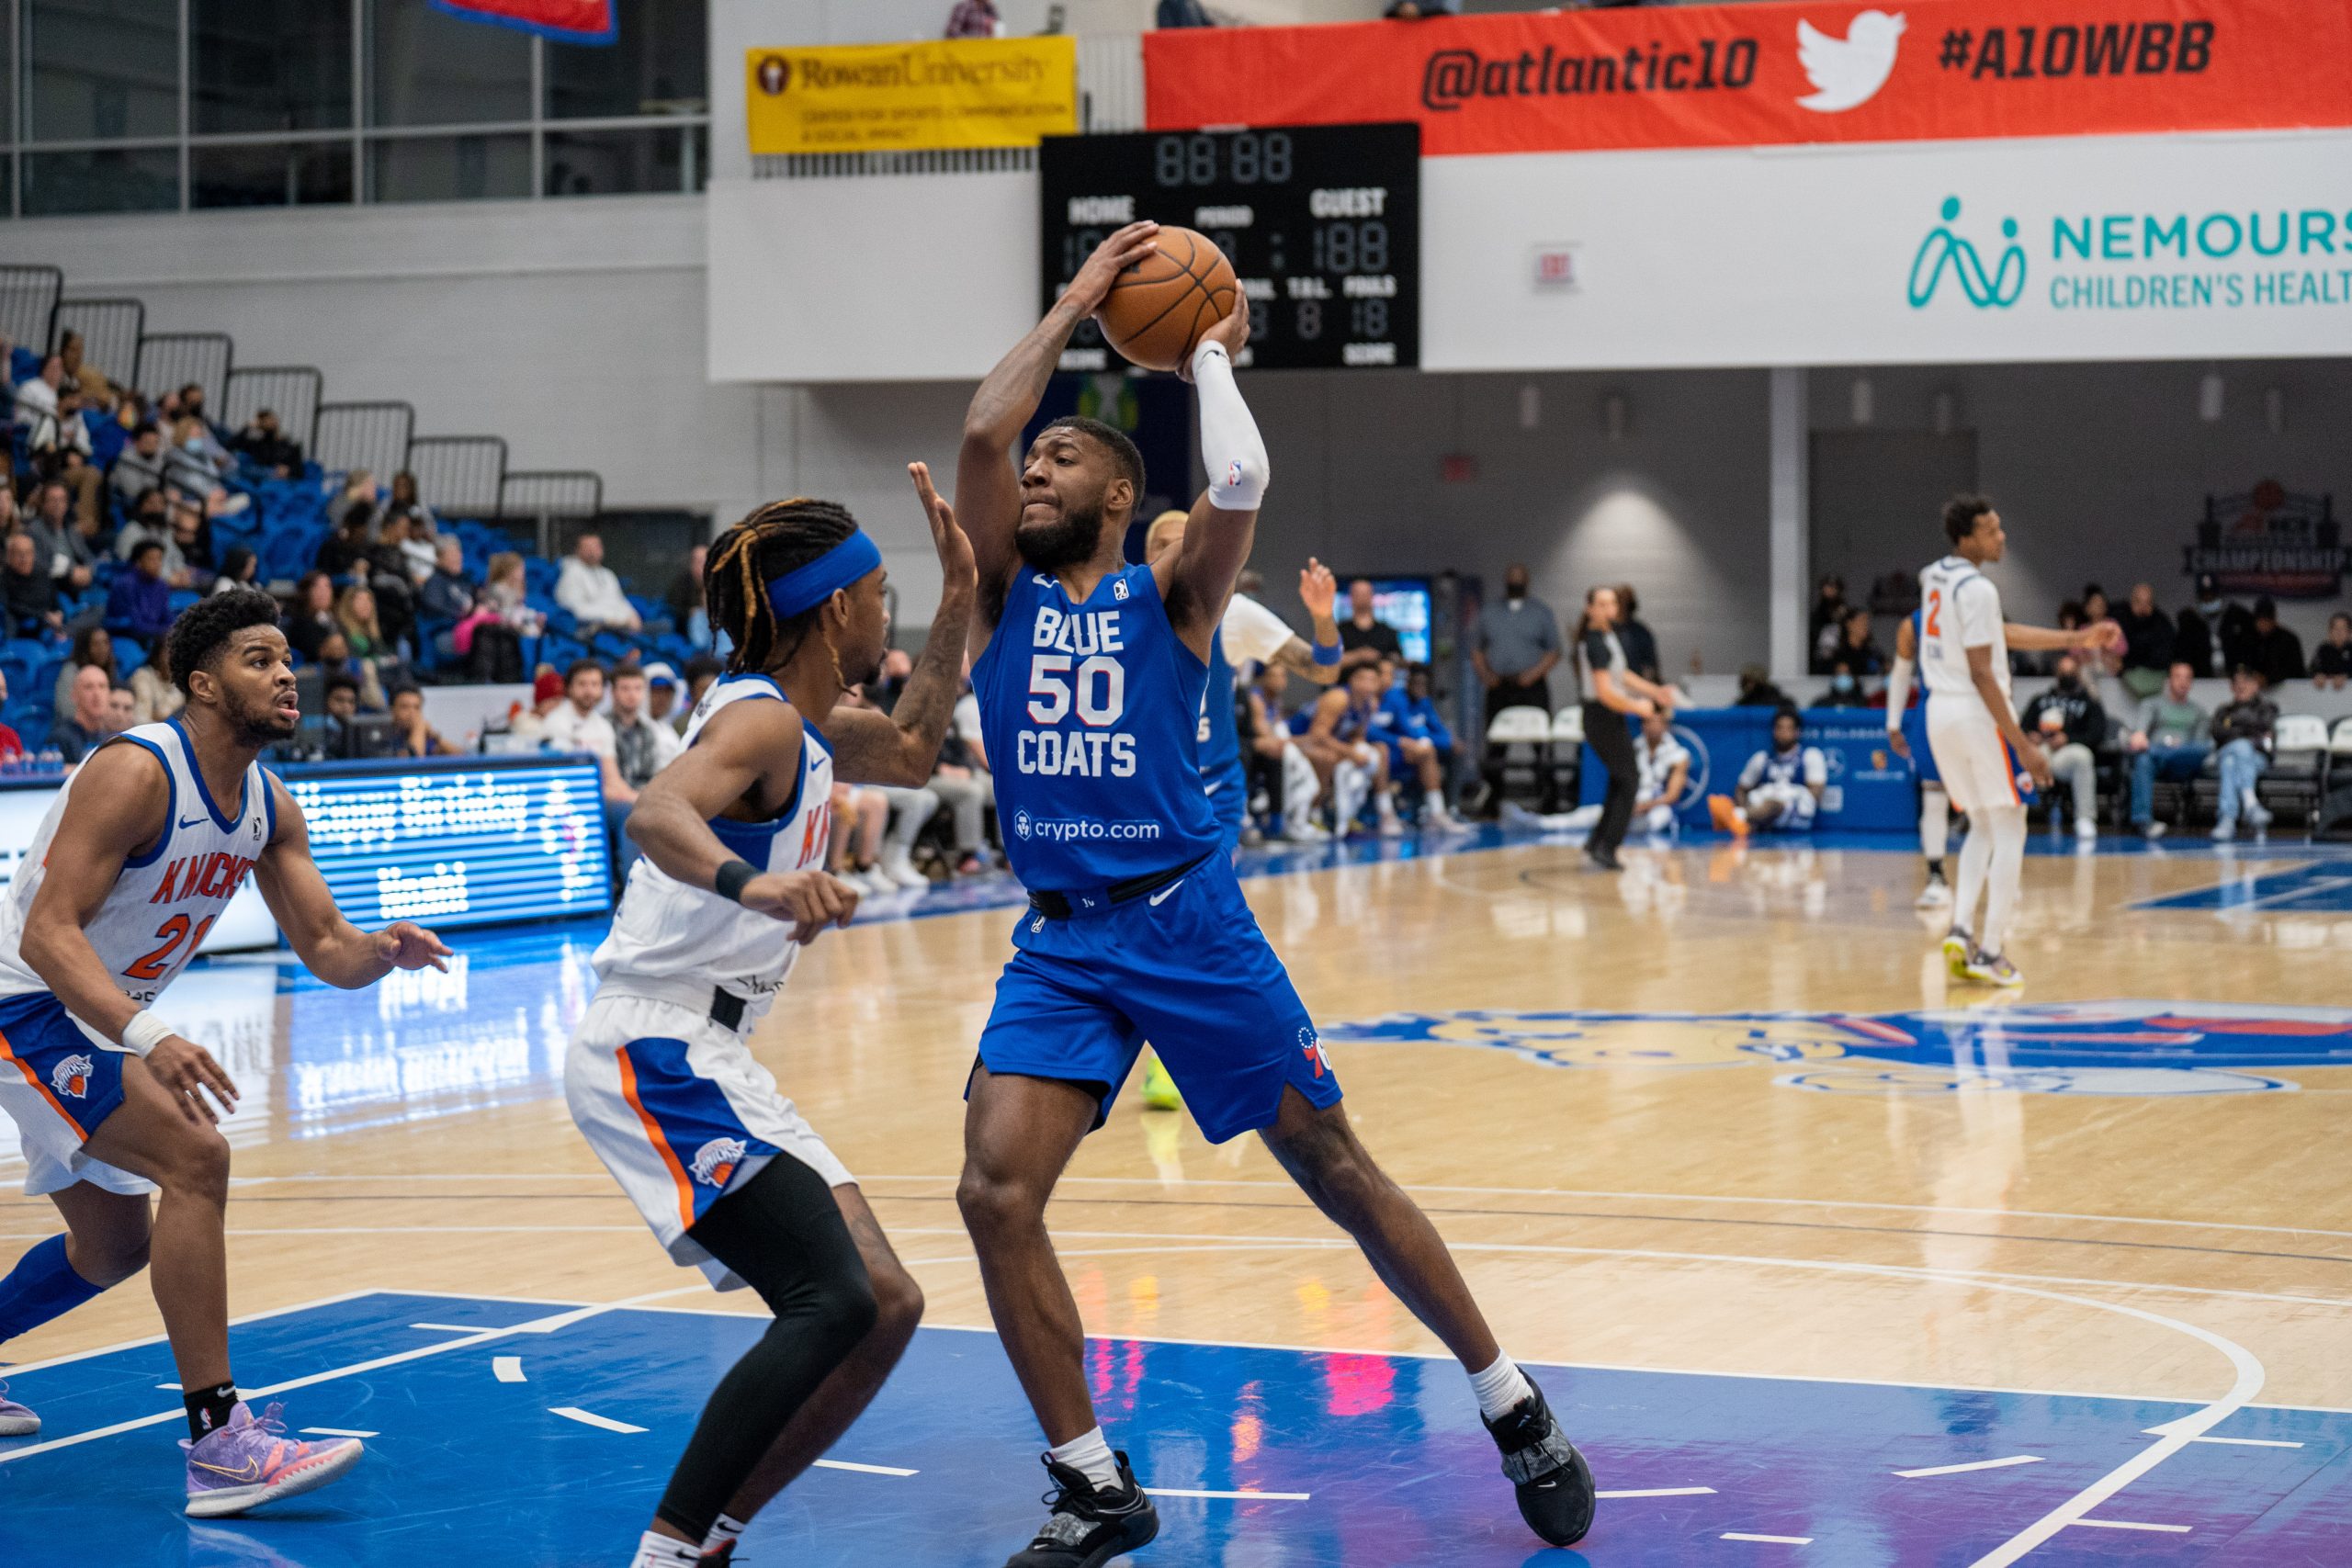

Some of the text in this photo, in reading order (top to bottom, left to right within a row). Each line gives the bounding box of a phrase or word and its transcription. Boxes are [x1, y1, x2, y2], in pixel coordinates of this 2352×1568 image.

[1939, 20, 2214, 79] #A10WBB
[1421, 39, 1758, 111] @atlantic10
[1068, 196, 1136, 224] HOME
[1310, 187, 1388, 218] GUEST
[2052, 209, 2352, 261] NEMOUR
[2050, 273, 2244, 309] CHILDREN'S
[1033, 605, 1125, 656] BLUE
[1926, 588, 1941, 637] 2
[1026, 654, 1125, 727] 50
[1017, 730, 1136, 778] COATS
[1035, 818, 1160, 841] crypto.com
[149, 852, 255, 904] KNICKS
